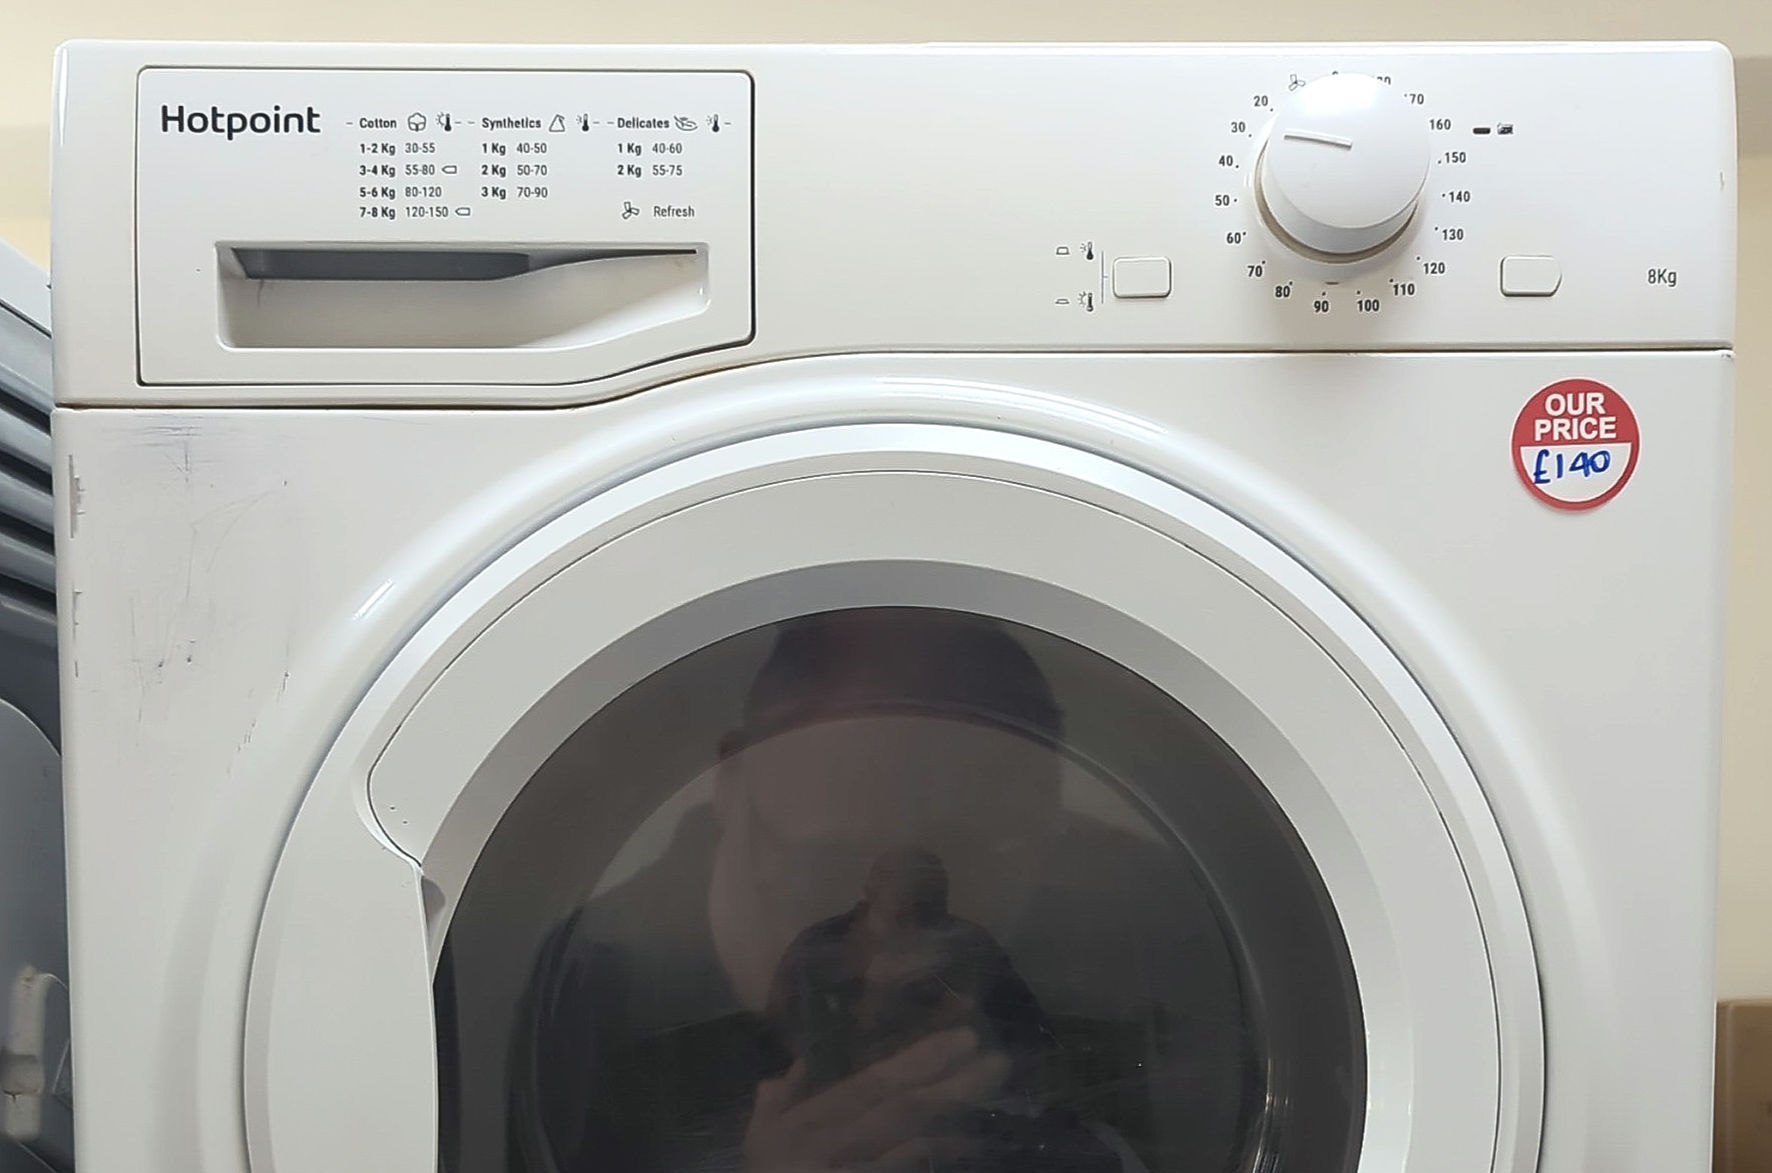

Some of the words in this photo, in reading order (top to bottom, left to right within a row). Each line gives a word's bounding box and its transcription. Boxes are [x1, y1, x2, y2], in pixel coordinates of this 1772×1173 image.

[1254, 95, 1268, 107] 20
[162, 105, 320, 140] Hotpoint
[360, 118, 396, 128] Cotton
[482, 117, 541, 130] Synthetics
[618, 117, 669, 128] Delicates
[1231, 122, 1245, 133] 30
[1430, 119, 1451, 130] 160
[360, 143, 378, 153] 1-2
[381, 143, 395, 156] Kg
[405, 143, 435, 153] 30-55
[483, 143, 487, 153] 1
[492, 143, 506, 156] Kg
[517, 143, 547, 153] 40-50
[618, 144, 622, 153] 1
[627, 143, 641, 156] Kg
[652, 143, 682, 153] 40-60
[1219, 155, 1233, 166] 40
[1445, 152, 1466, 163] 150
[360, 165, 377, 175] 3-4
[381, 165, 395, 177] Kg
[405, 164, 435, 175] 55-80
[482, 165, 488, 175] 2
[492, 165, 506, 177] Kg
[518, 165, 547, 175] 50-70
[618, 165, 624, 175] 2
[627, 165, 641, 178] Kg
[653, 165, 682, 176] 55-75
[360, 187, 378, 197] 5-6
[382, 187, 395, 200] Kg
[405, 187, 441, 197] 80-120
[481, 187, 488, 197] 3
[492, 187, 506, 200] Kg
[517, 187, 548, 198] 70-90
[1449, 191, 1470, 202] 140
[1215, 195, 1229, 206] 50
[360, 207, 378, 217] 7-8
[382, 207, 395, 220] Kg
[406, 207, 448, 217] 120-150
[654, 205, 694, 217] Refresh
[1227, 232, 1241, 244] 60
[1443, 229, 1463, 240] 130
[1248, 266, 1262, 277] 70
[1424, 262, 1445, 274] 120
[1648, 269, 1676, 287] 8Kg
[1276, 286, 1290, 297] 80
[1394, 284, 1415, 295] 110
[1314, 301, 1328, 312] 90
[1358, 299, 1379, 311] 100
[1545, 393, 1605, 416] OUR
[1535, 416, 1617, 441] PRICE
[1533, 449, 1611, 484] £140
